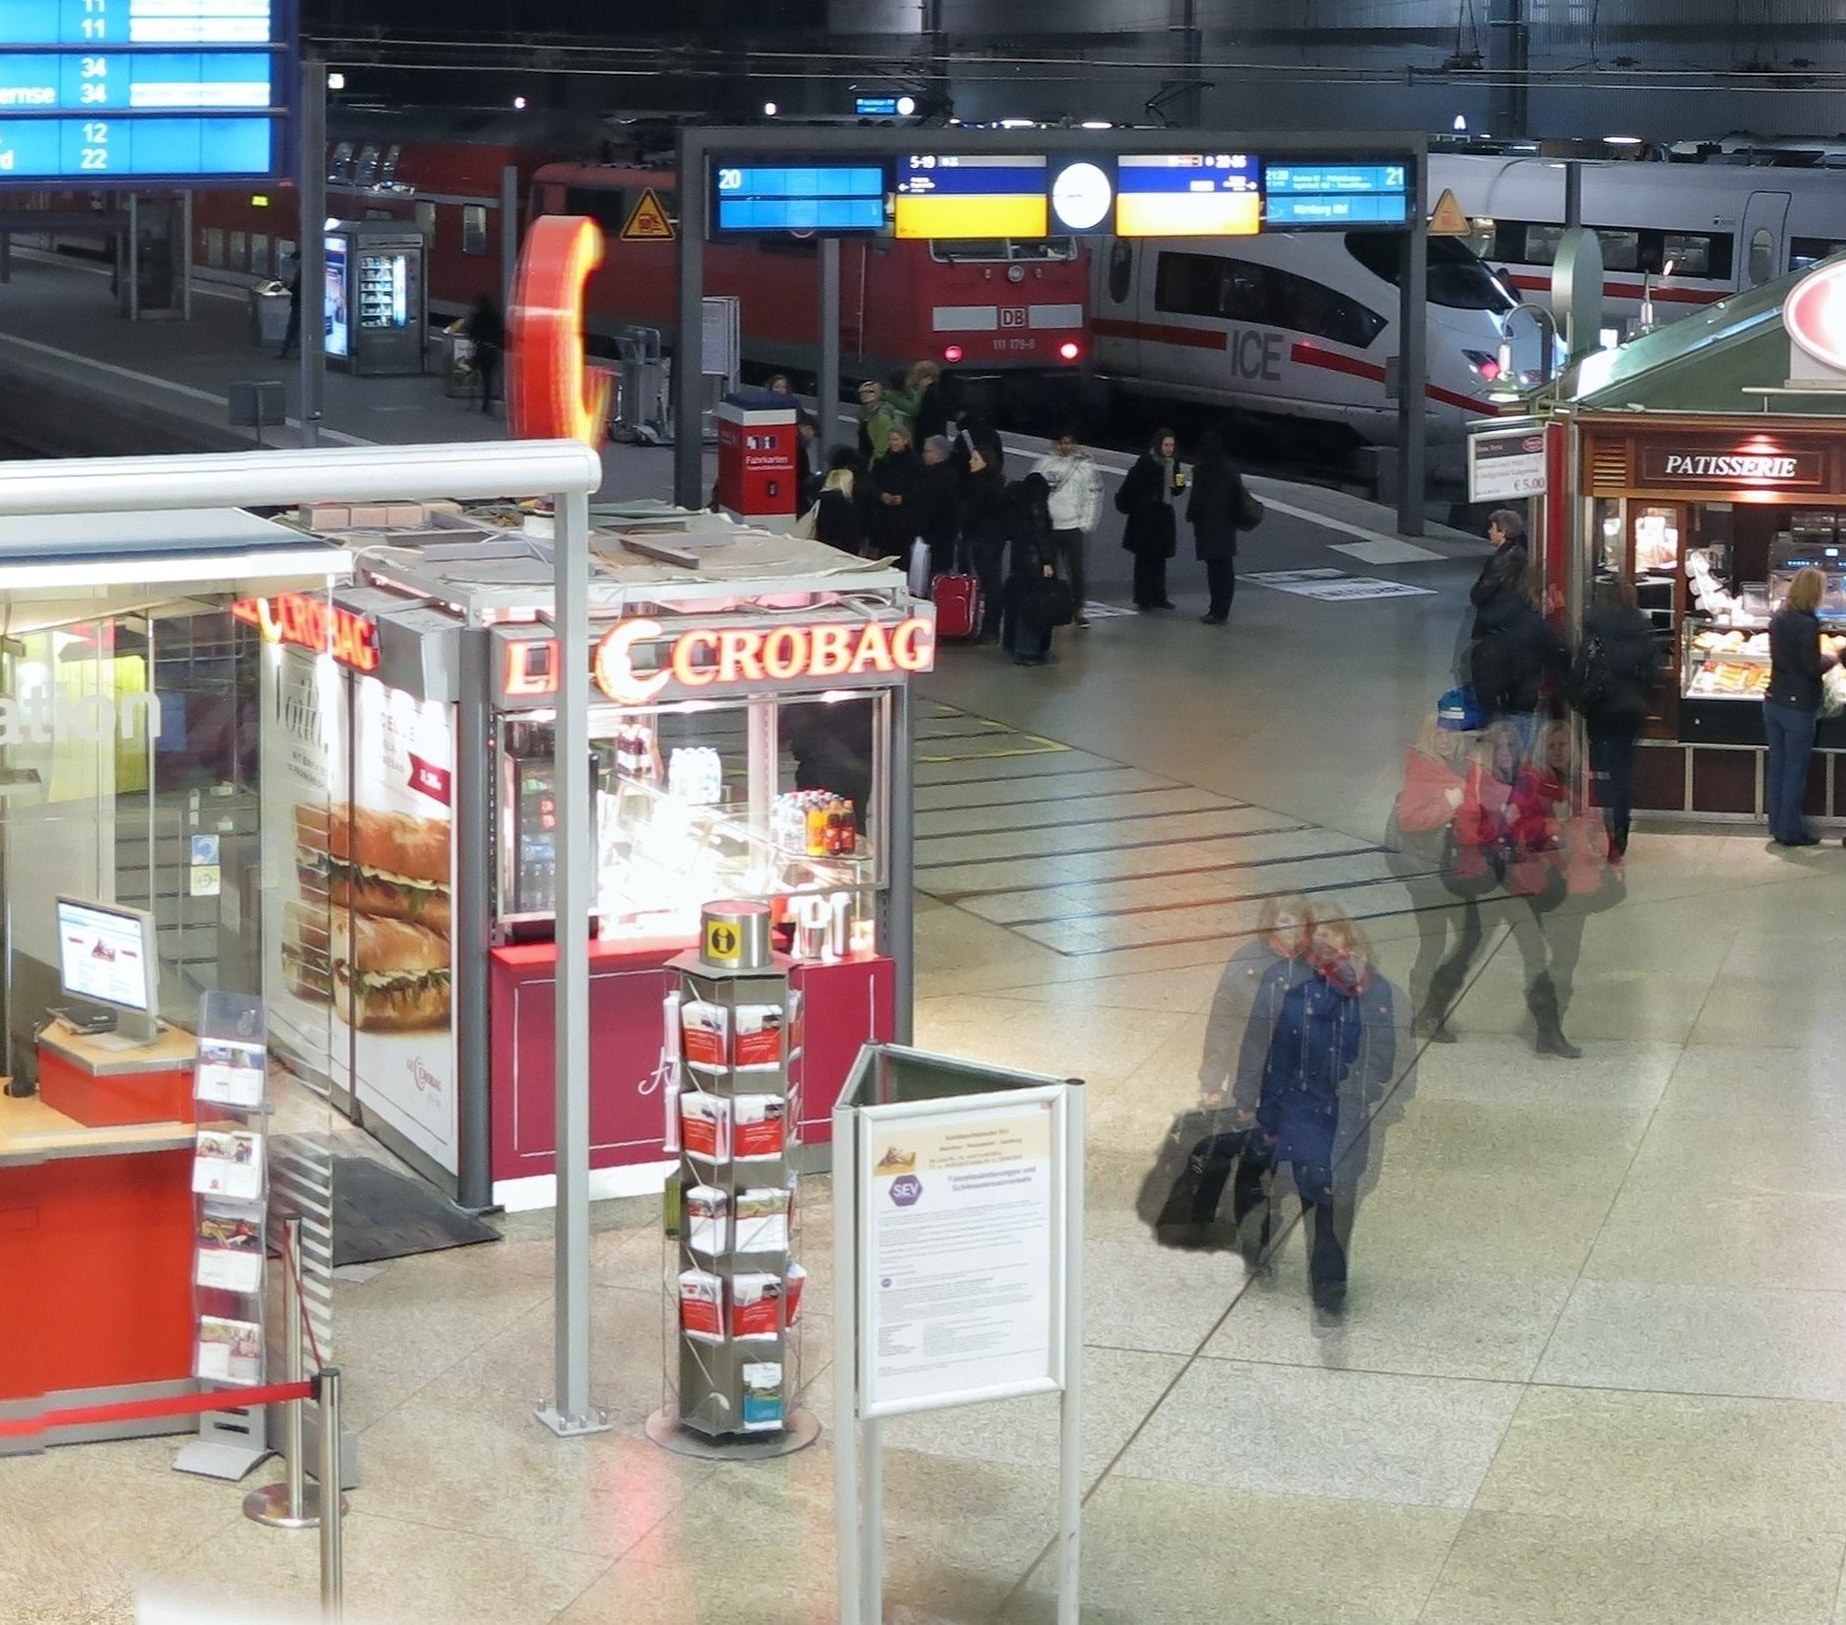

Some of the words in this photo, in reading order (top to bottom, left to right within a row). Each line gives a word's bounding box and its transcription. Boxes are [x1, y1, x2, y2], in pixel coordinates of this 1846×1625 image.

[81, 18, 106, 39] 11
[81, 58, 106, 78] 34
[81, 85, 106, 104] 34
[82, 123, 107, 143] 12
[81, 151, 107, 170] 22
[719, 169, 741, 189] 20
[1385, 167, 1404, 186] 21
[1003, 309, 1024, 326] DB
[1232, 329, 1284, 381] ICE
[1665, 455, 1798, 479] PATISSERIE
[674, 618, 935, 687] CROBAG
[892, 1182, 919, 1198] SEV
